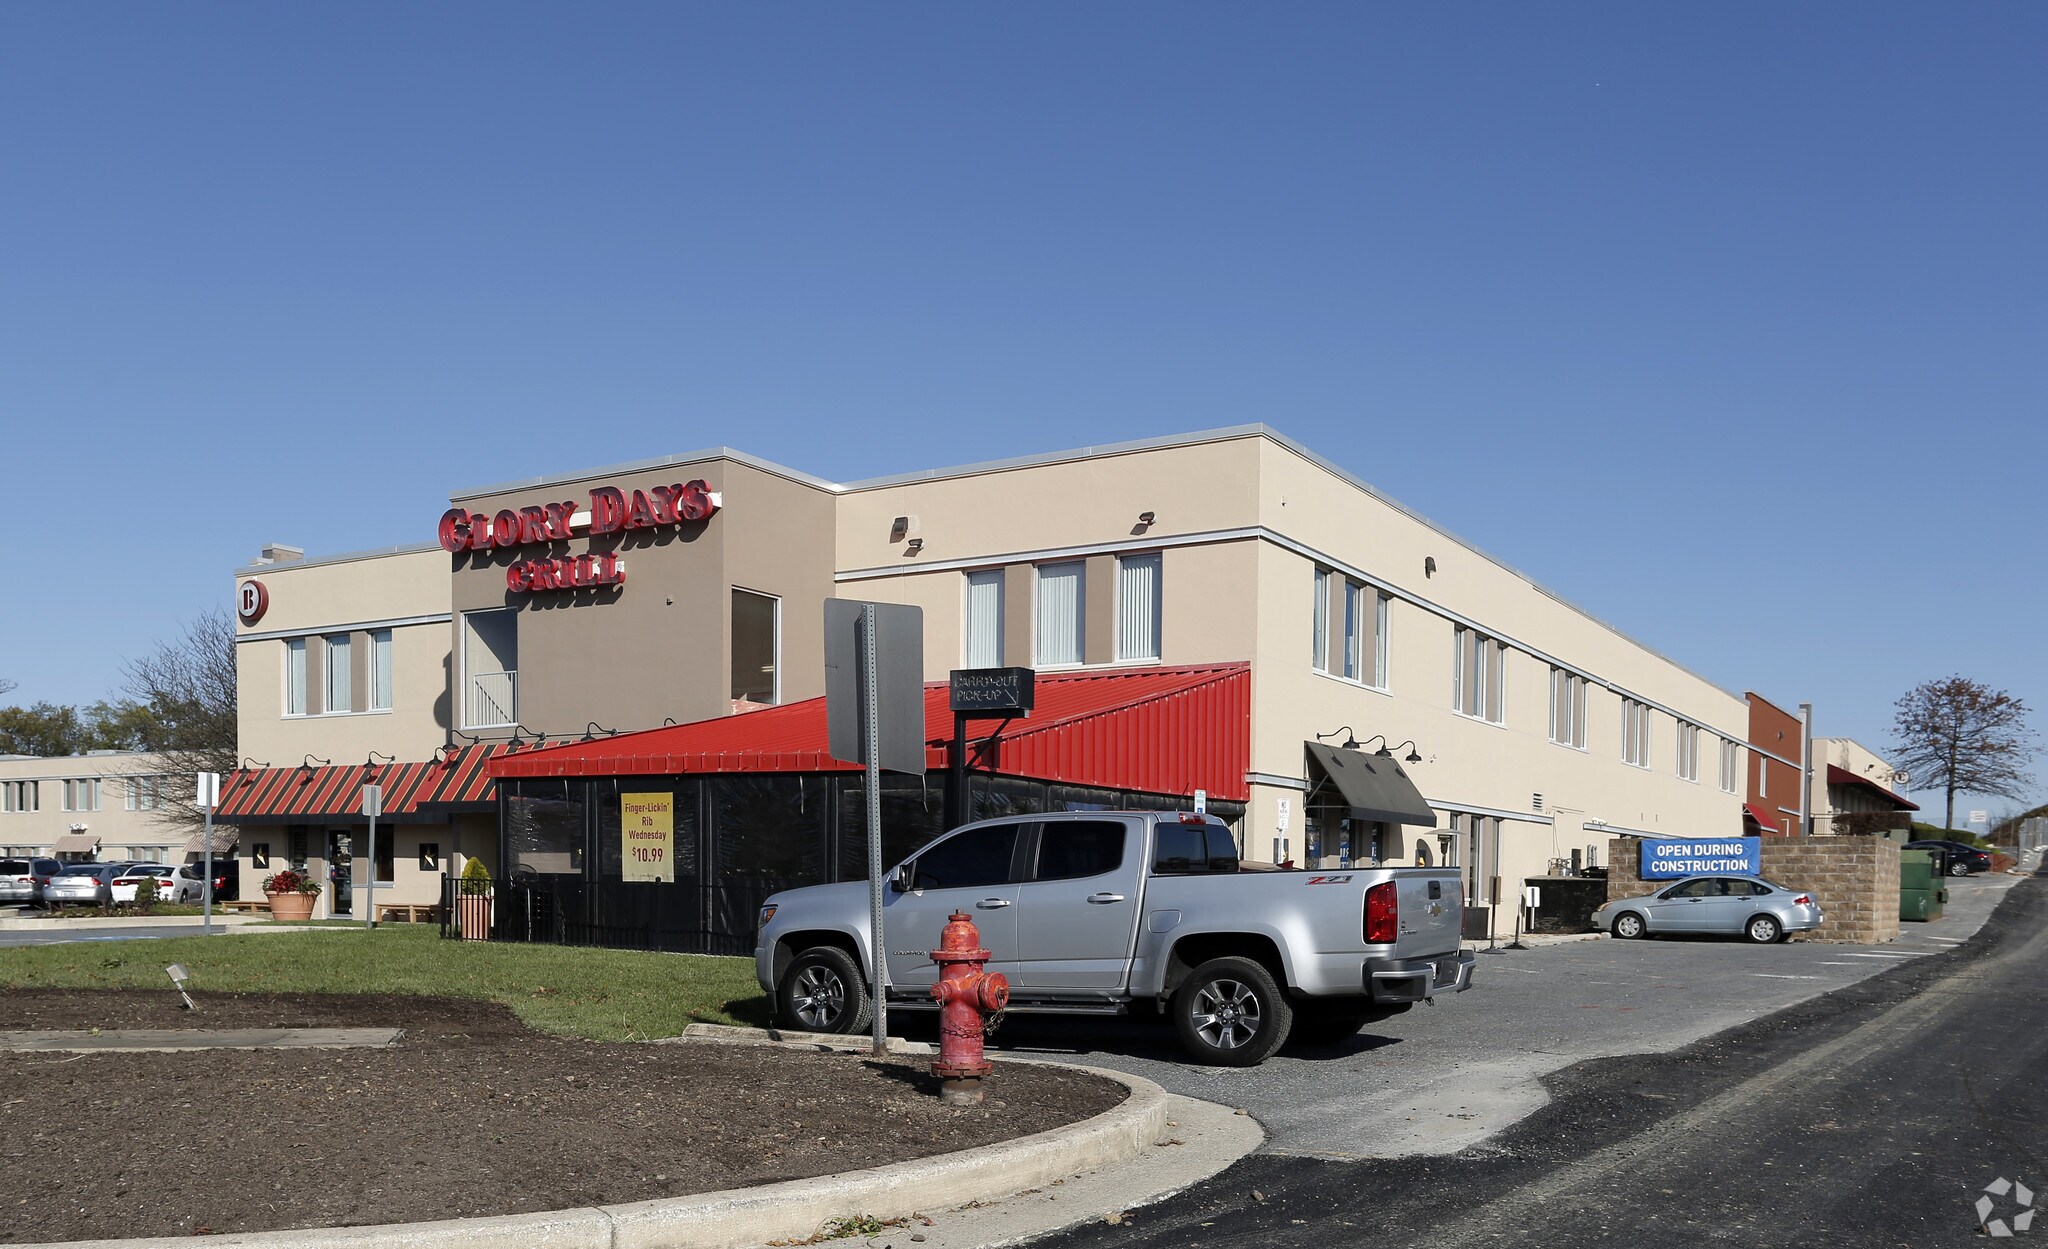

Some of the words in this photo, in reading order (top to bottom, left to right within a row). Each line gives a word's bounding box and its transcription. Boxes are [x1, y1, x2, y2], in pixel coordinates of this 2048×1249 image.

[438, 501, 579, 552] GLORY
[588, 478, 713, 535] DAYS
[506, 551, 627, 593] GRILL
[243, 589, 254, 610] B
[954, 674, 1018, 688] CARRY-OUT
[956, 689, 1001, 702] PICK-UP
[625, 802, 670, 814] Finger-Lickin'
[641, 816, 653, 826] Rib
[628, 830, 667, 841] Wednesday
[632, 846, 663, 862] $10.99
[1656, 845, 1691, 857] OPEN
[1694, 844, 1743, 856] DURING
[1651, 859, 1748, 872] CONSTRUCTION
[1305, 874, 1354, 885] Z71
